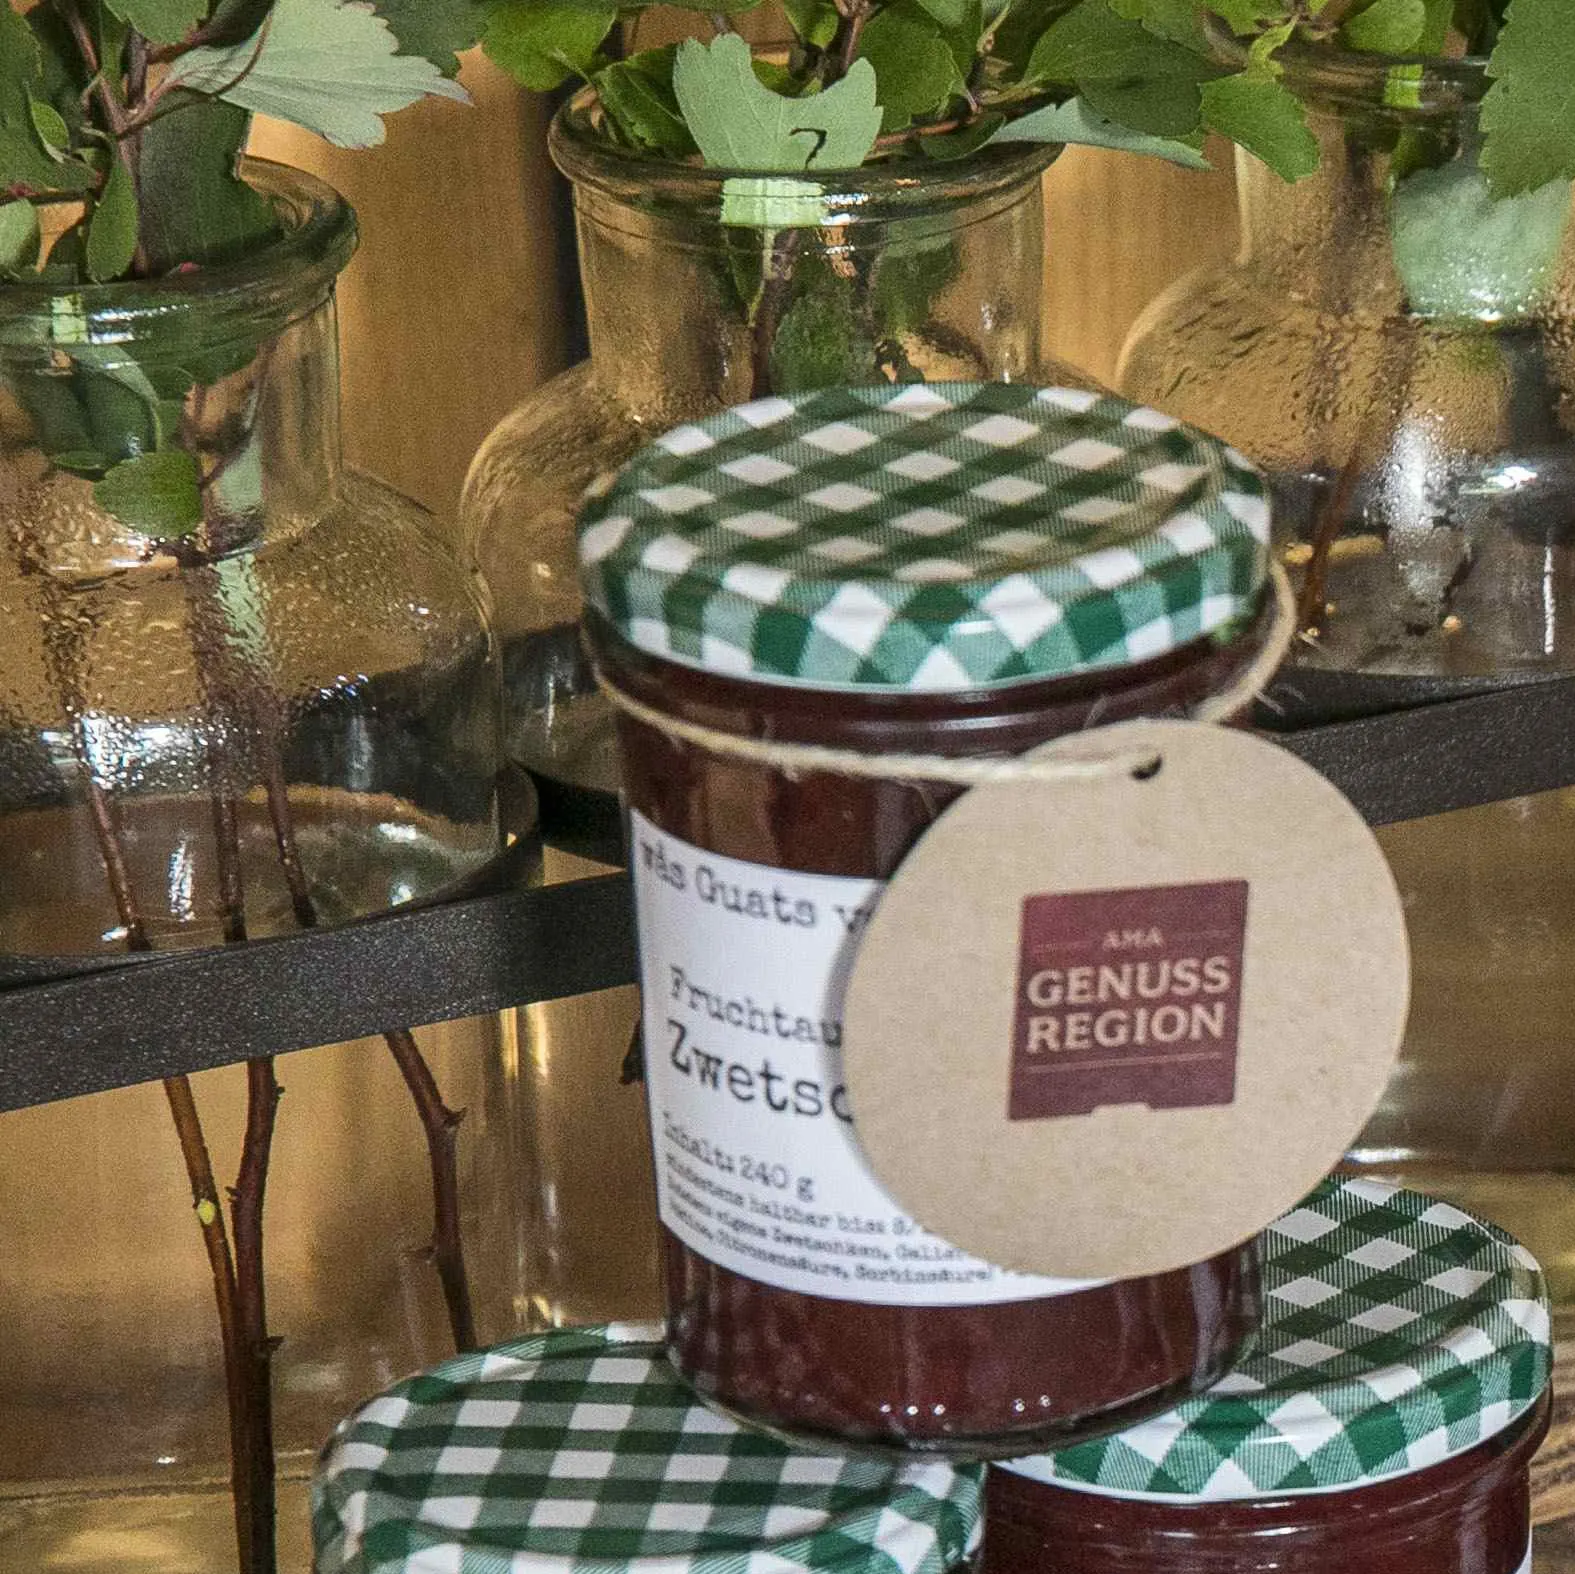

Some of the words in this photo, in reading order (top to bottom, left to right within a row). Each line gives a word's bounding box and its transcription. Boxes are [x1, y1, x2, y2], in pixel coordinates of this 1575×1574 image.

[696, 864, 815, 927] Guats
[1103, 926, 1165, 952] AMA
[671, 964, 842, 1048] Fruchtau
[1026, 955, 1232, 1009] GENUSS
[1026, 1001, 1227, 1054] REGION
[668, 1017, 853, 1123] Zwetsc
